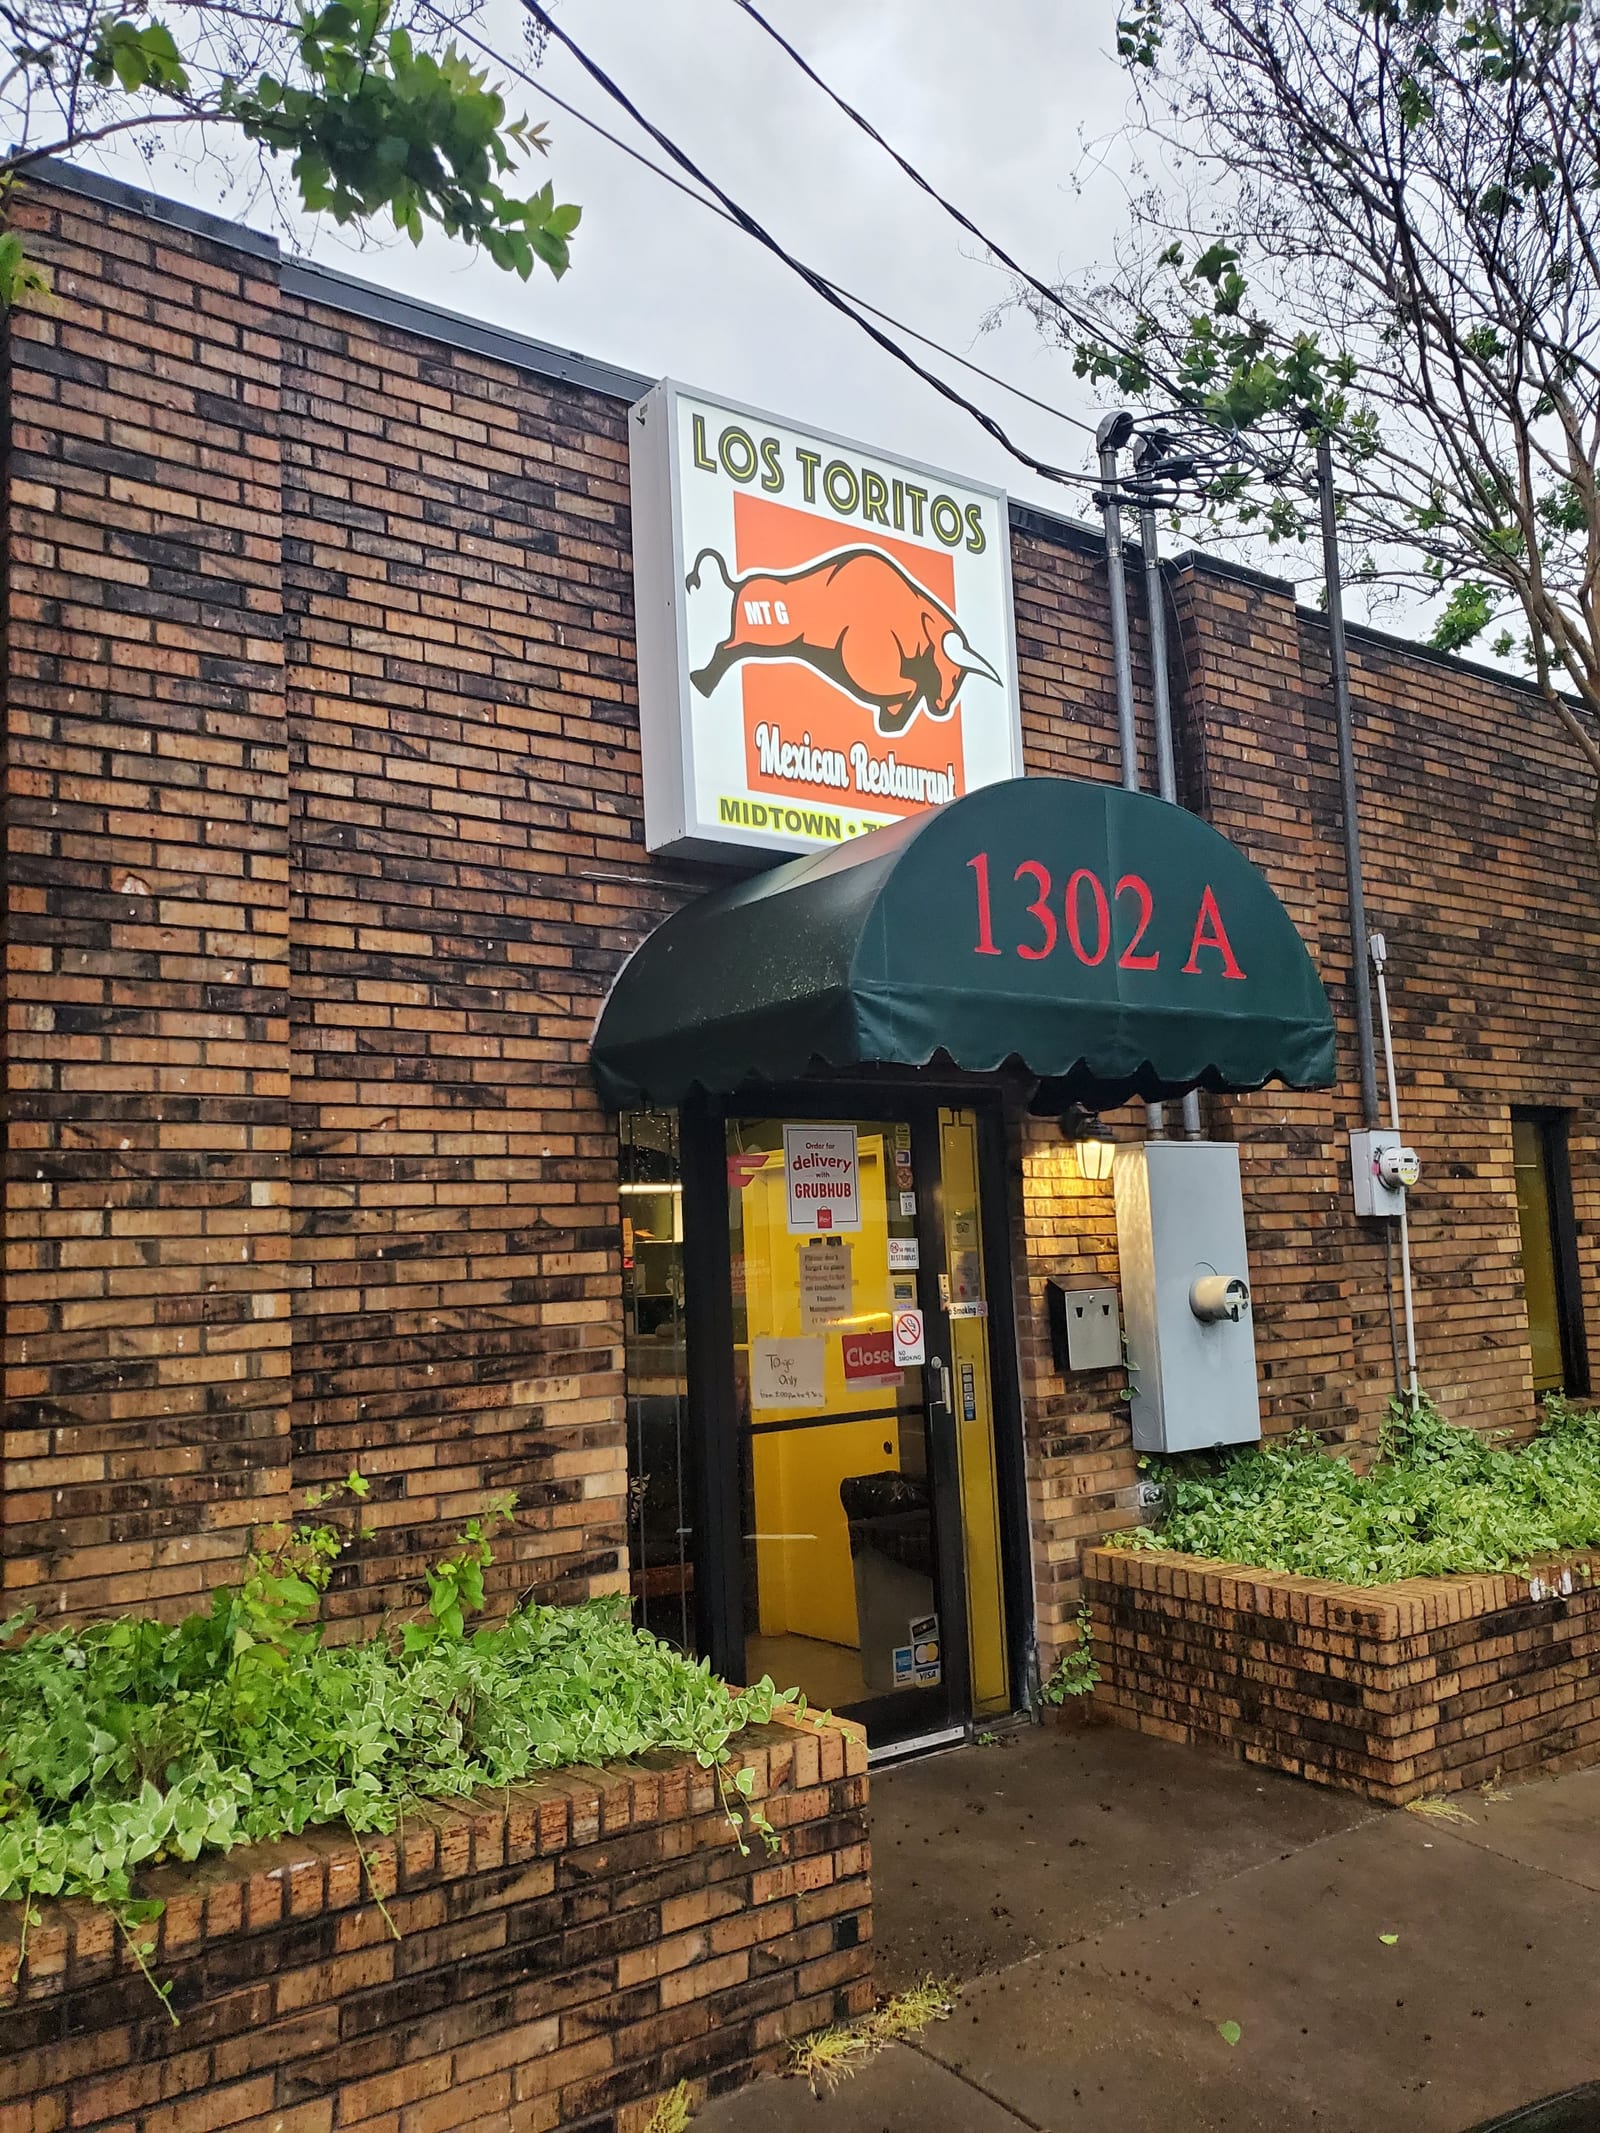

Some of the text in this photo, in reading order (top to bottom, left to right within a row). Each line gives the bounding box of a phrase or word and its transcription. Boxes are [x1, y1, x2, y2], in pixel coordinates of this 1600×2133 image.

[692, 413, 986, 554] LOS TORITOS
[755, 721, 957, 805] Mexican Restaurant
[719, 797, 842, 839] MIDTOWN
[966, 852, 1248, 980] 1302 A
[805, 1142, 836, 1150] Order for
[792, 1152, 852, 1174] delivery
[795, 1182, 852, 1199] GRUBHUB
[953, 1305, 977, 1316] Smoking
[846, 1346, 894, 1368] Close
[778, 1374, 798, 1388] Only
[919, 1670, 937, 1681] VISA
